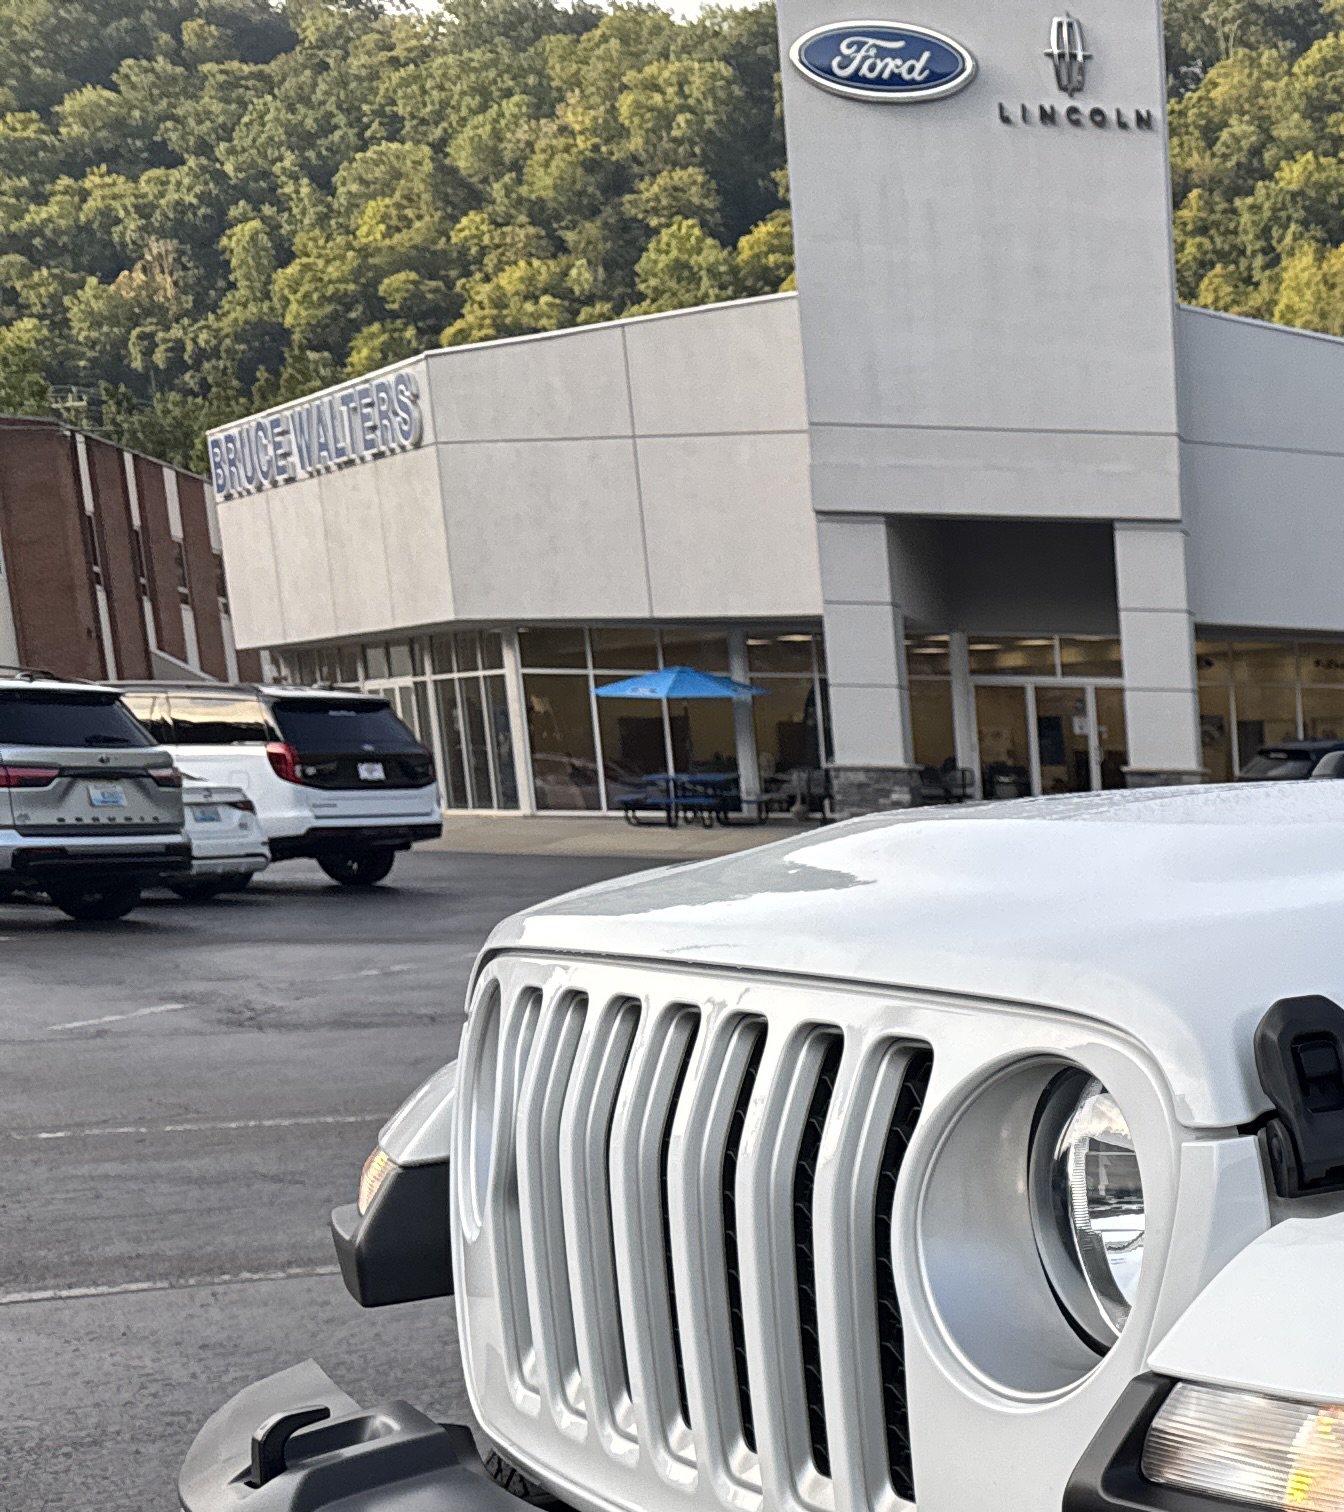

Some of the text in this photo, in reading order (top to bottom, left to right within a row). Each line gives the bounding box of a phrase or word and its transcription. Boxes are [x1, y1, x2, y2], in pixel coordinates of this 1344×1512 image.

[830, 35, 932, 84] Ford
[997, 101, 1155, 132] LINCOLN
[209, 372, 423, 497] BRUCE WALTERS
